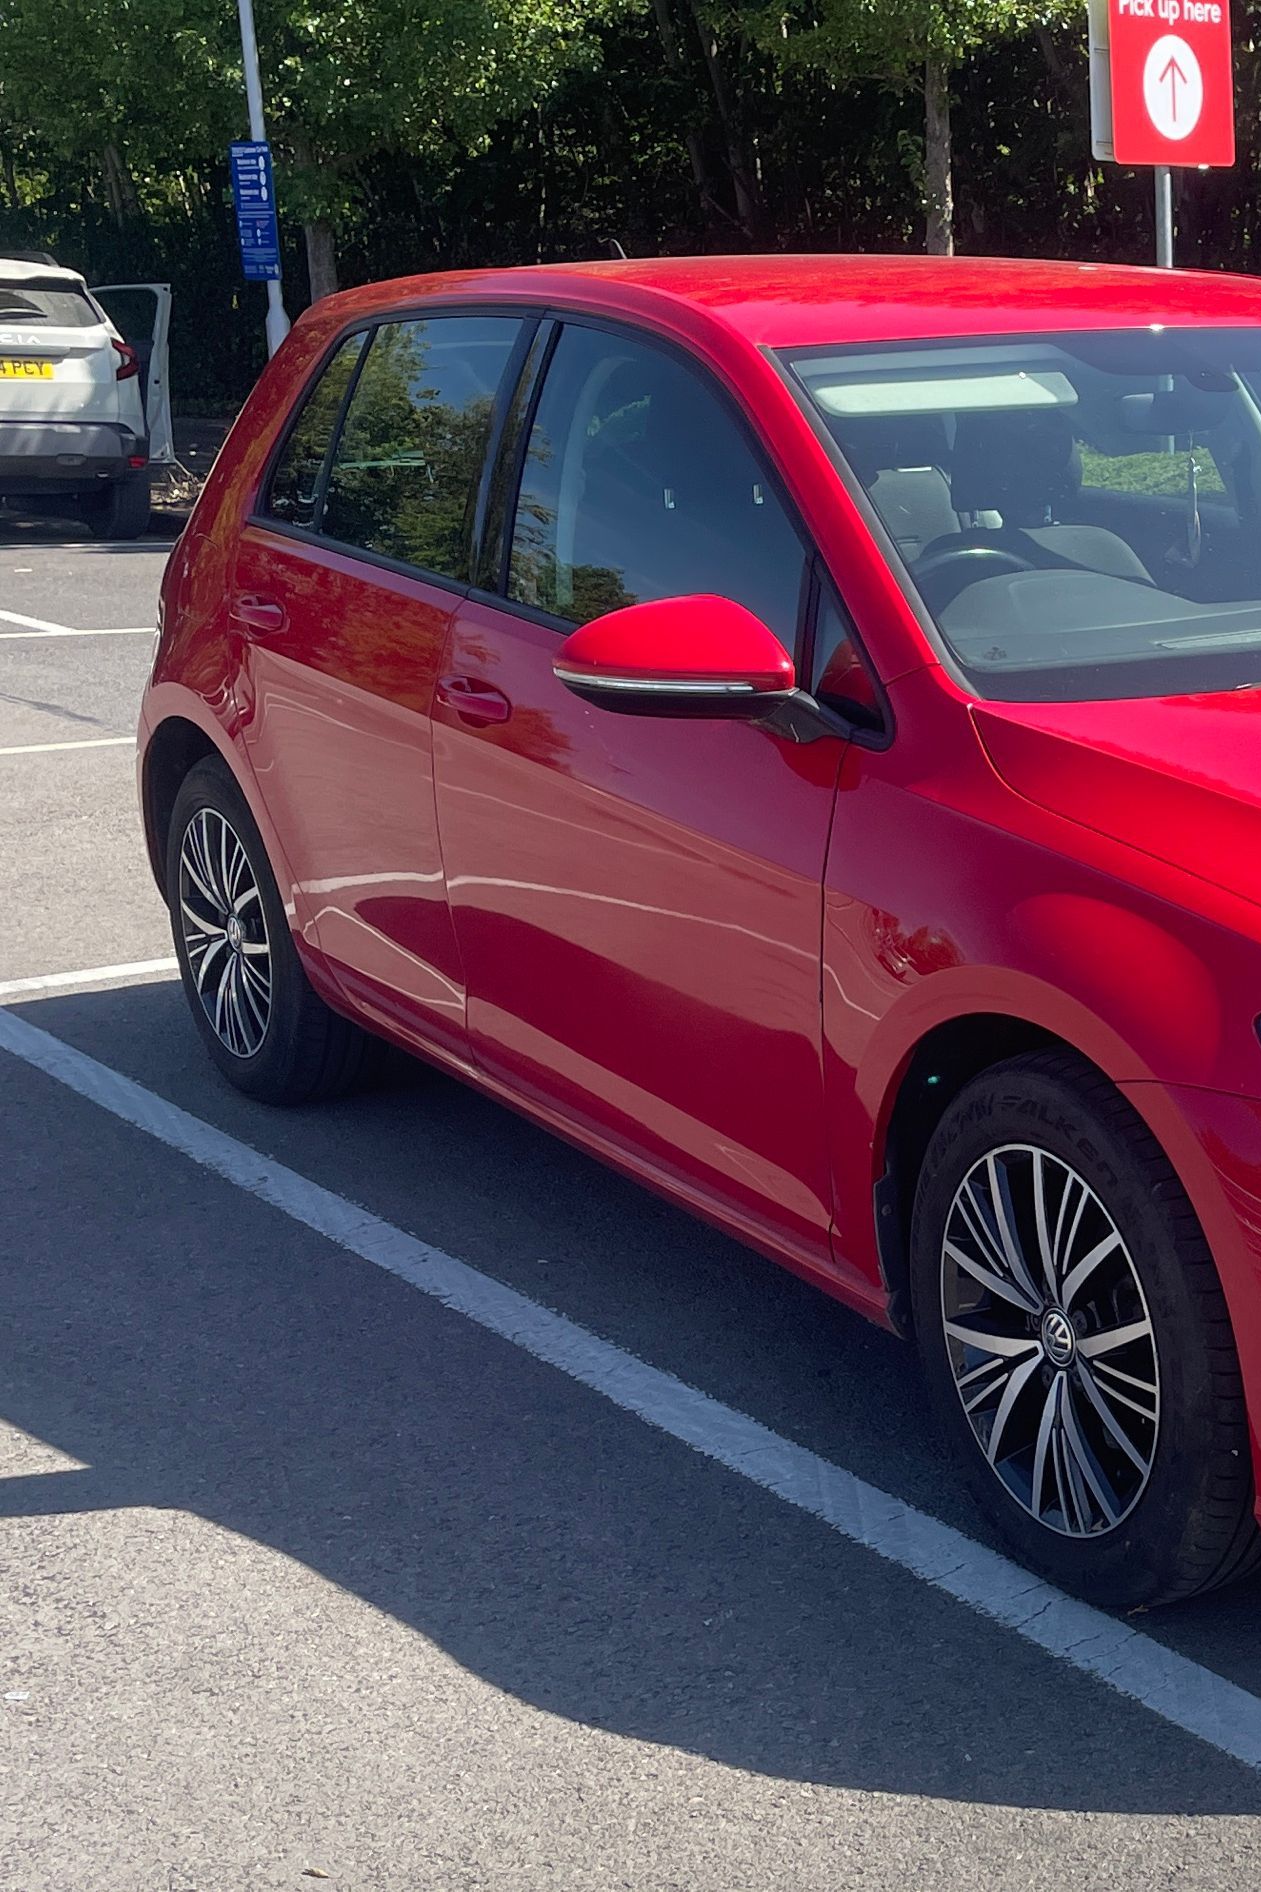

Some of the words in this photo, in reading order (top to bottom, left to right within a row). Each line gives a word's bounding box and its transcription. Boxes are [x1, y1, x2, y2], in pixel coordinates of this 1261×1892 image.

[1119, 0, 1155, 17] Pick
[1158, 0, 1180, 26] up
[1184, 0, 1222, 23] here
[12, 360, 44, 376] PCY
